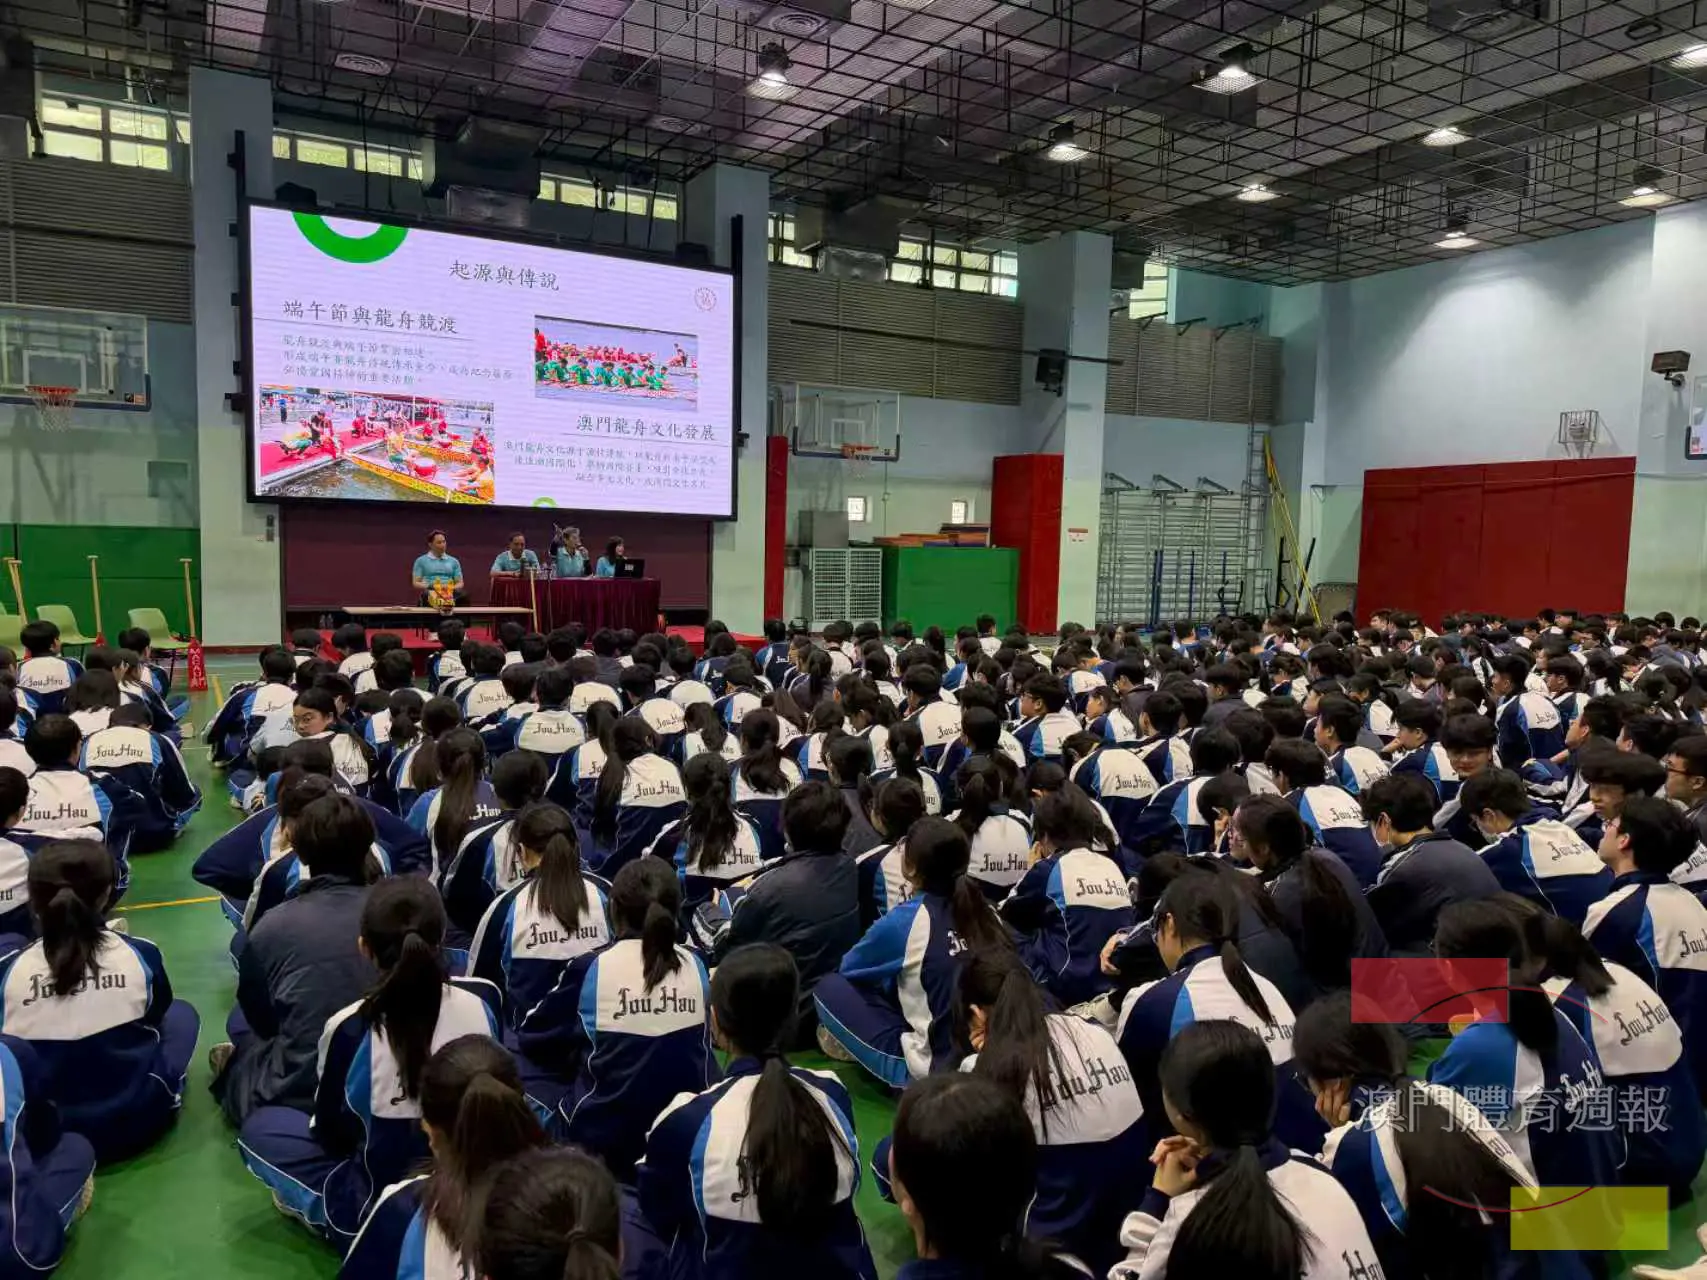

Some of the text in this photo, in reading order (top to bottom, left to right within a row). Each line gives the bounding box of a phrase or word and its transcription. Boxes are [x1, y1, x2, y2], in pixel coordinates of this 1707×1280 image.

[449, 260, 560, 291] 起源與傳說
[283, 300, 458, 334] 端午節與龍舟競渡
[577, 415, 715, 441] 澳門龍舟文化發展
[653, 985, 696, 1015] Hau
